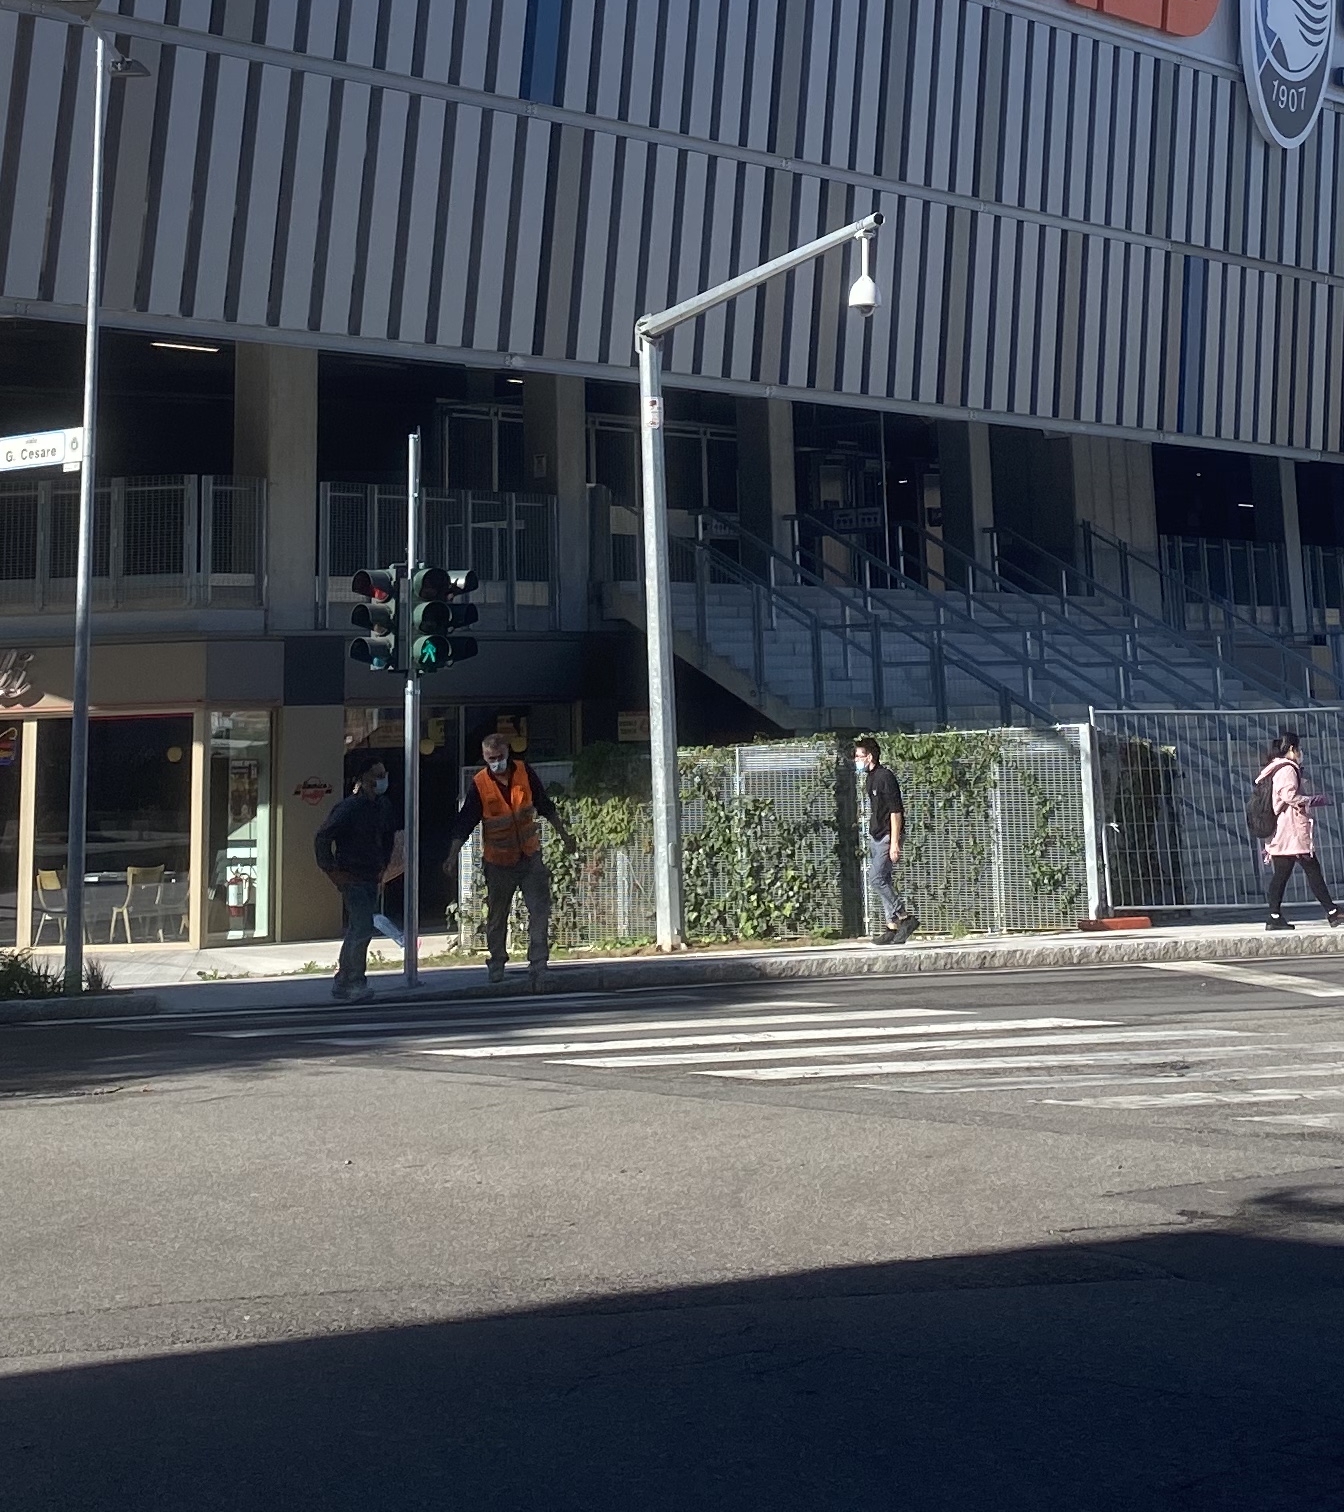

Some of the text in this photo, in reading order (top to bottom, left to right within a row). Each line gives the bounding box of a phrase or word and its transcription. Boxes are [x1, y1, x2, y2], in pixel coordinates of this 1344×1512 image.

[1272, 79, 1306, 113] 1907
[5, 447, 57, 462] G. Cesare
